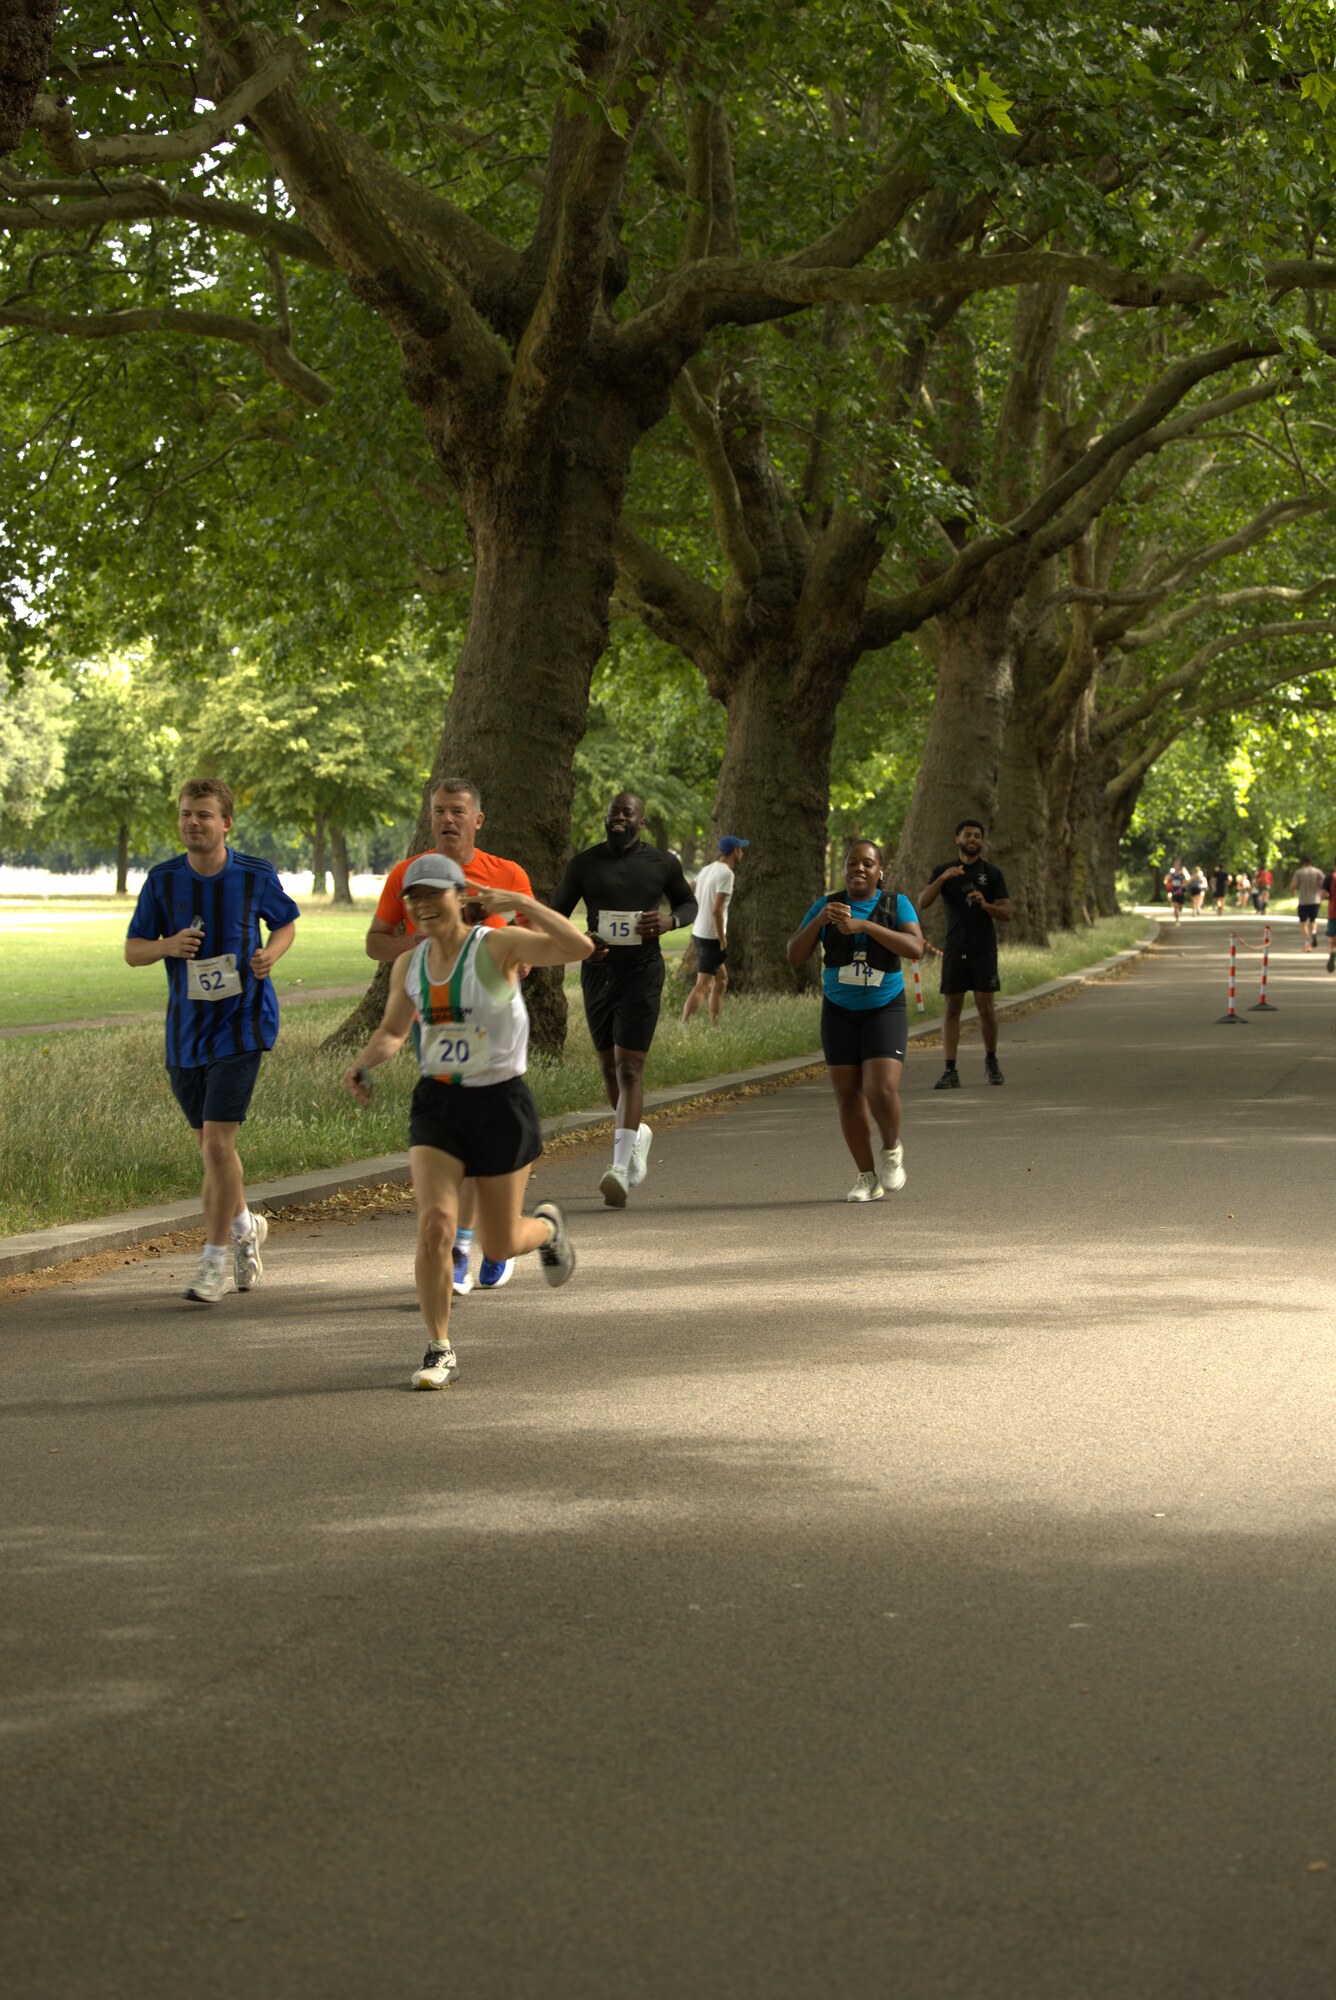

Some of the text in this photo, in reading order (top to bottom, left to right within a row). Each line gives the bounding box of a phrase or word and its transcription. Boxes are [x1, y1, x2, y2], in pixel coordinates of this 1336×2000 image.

[609, 922, 630, 937] 15
[199, 970, 226, 991] 62
[439, 1039, 470, 1063] 20
